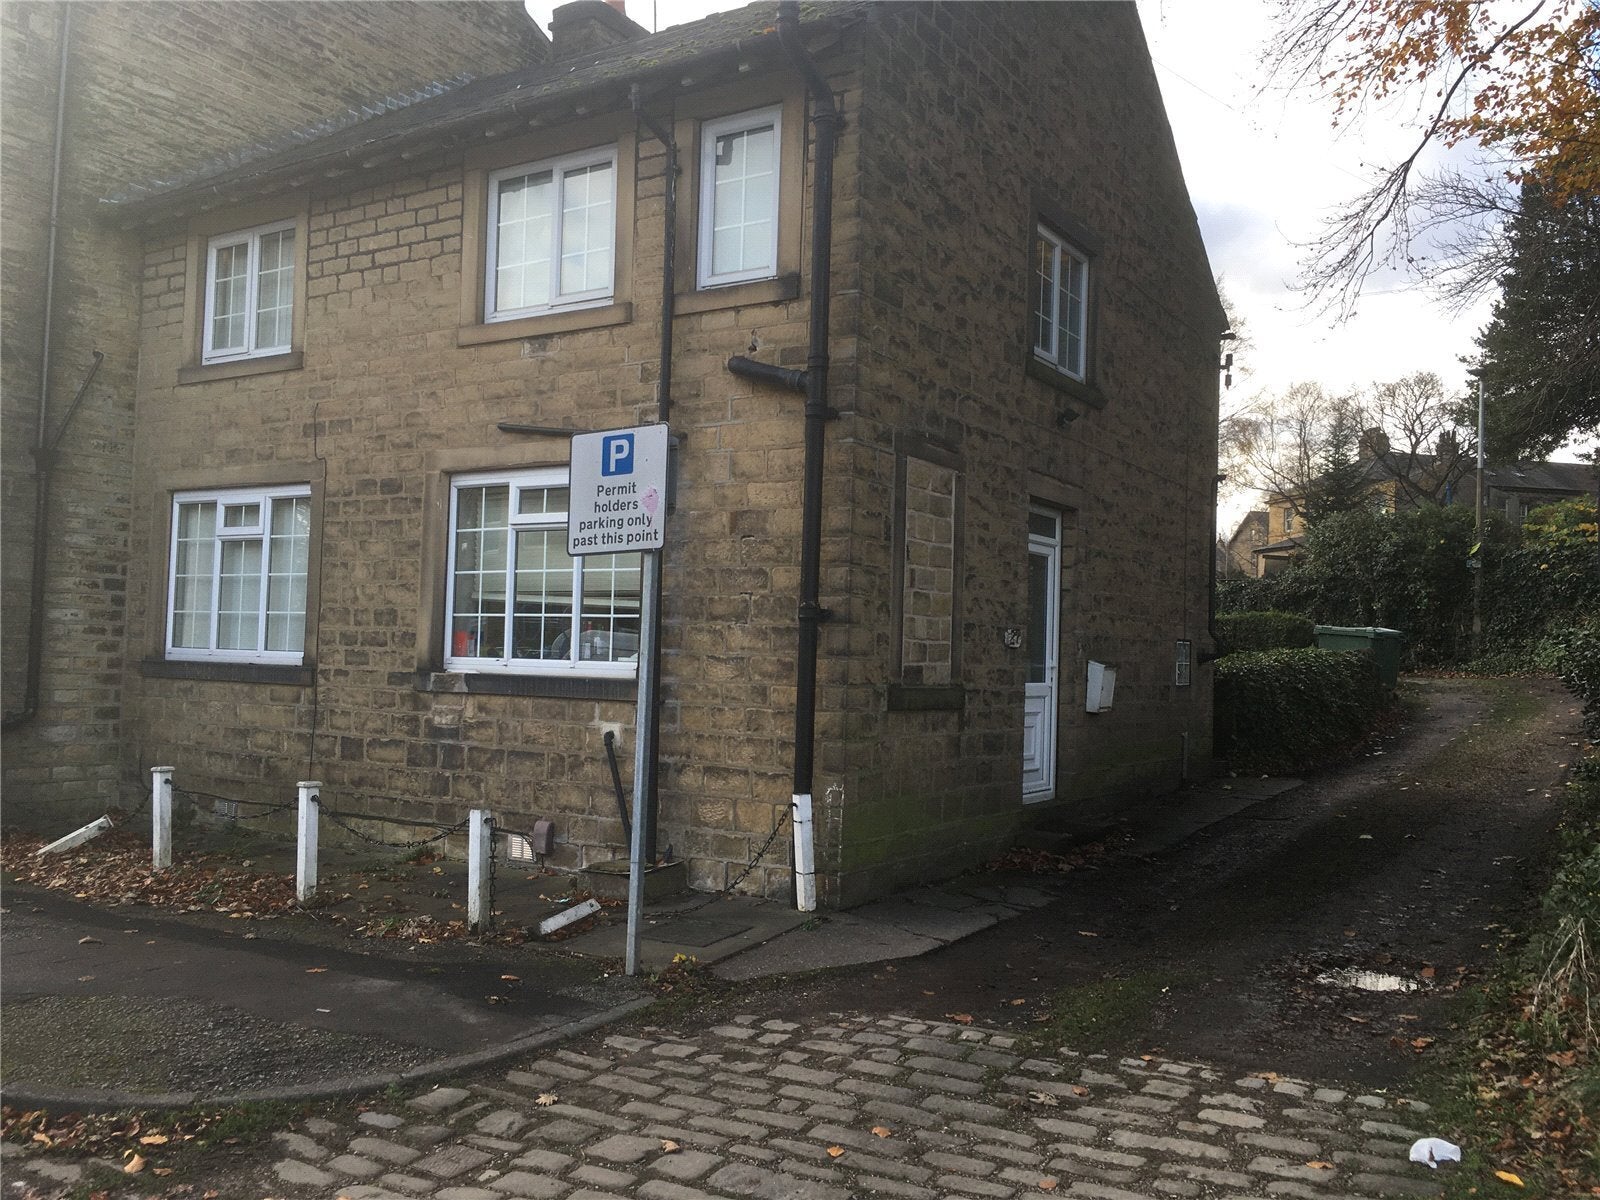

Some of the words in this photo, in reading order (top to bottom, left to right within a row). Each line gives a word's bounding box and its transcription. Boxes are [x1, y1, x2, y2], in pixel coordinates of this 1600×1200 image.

[609, 438, 630, 472] P
[597, 482, 637, 497] Permit
[594, 500, 639, 513] holders
[579, 516, 624, 532] parking
[627, 513, 653, 528] only
[573, 533, 598, 549] past
[601, 532, 624, 545] this
[626, 529, 659, 545] point
